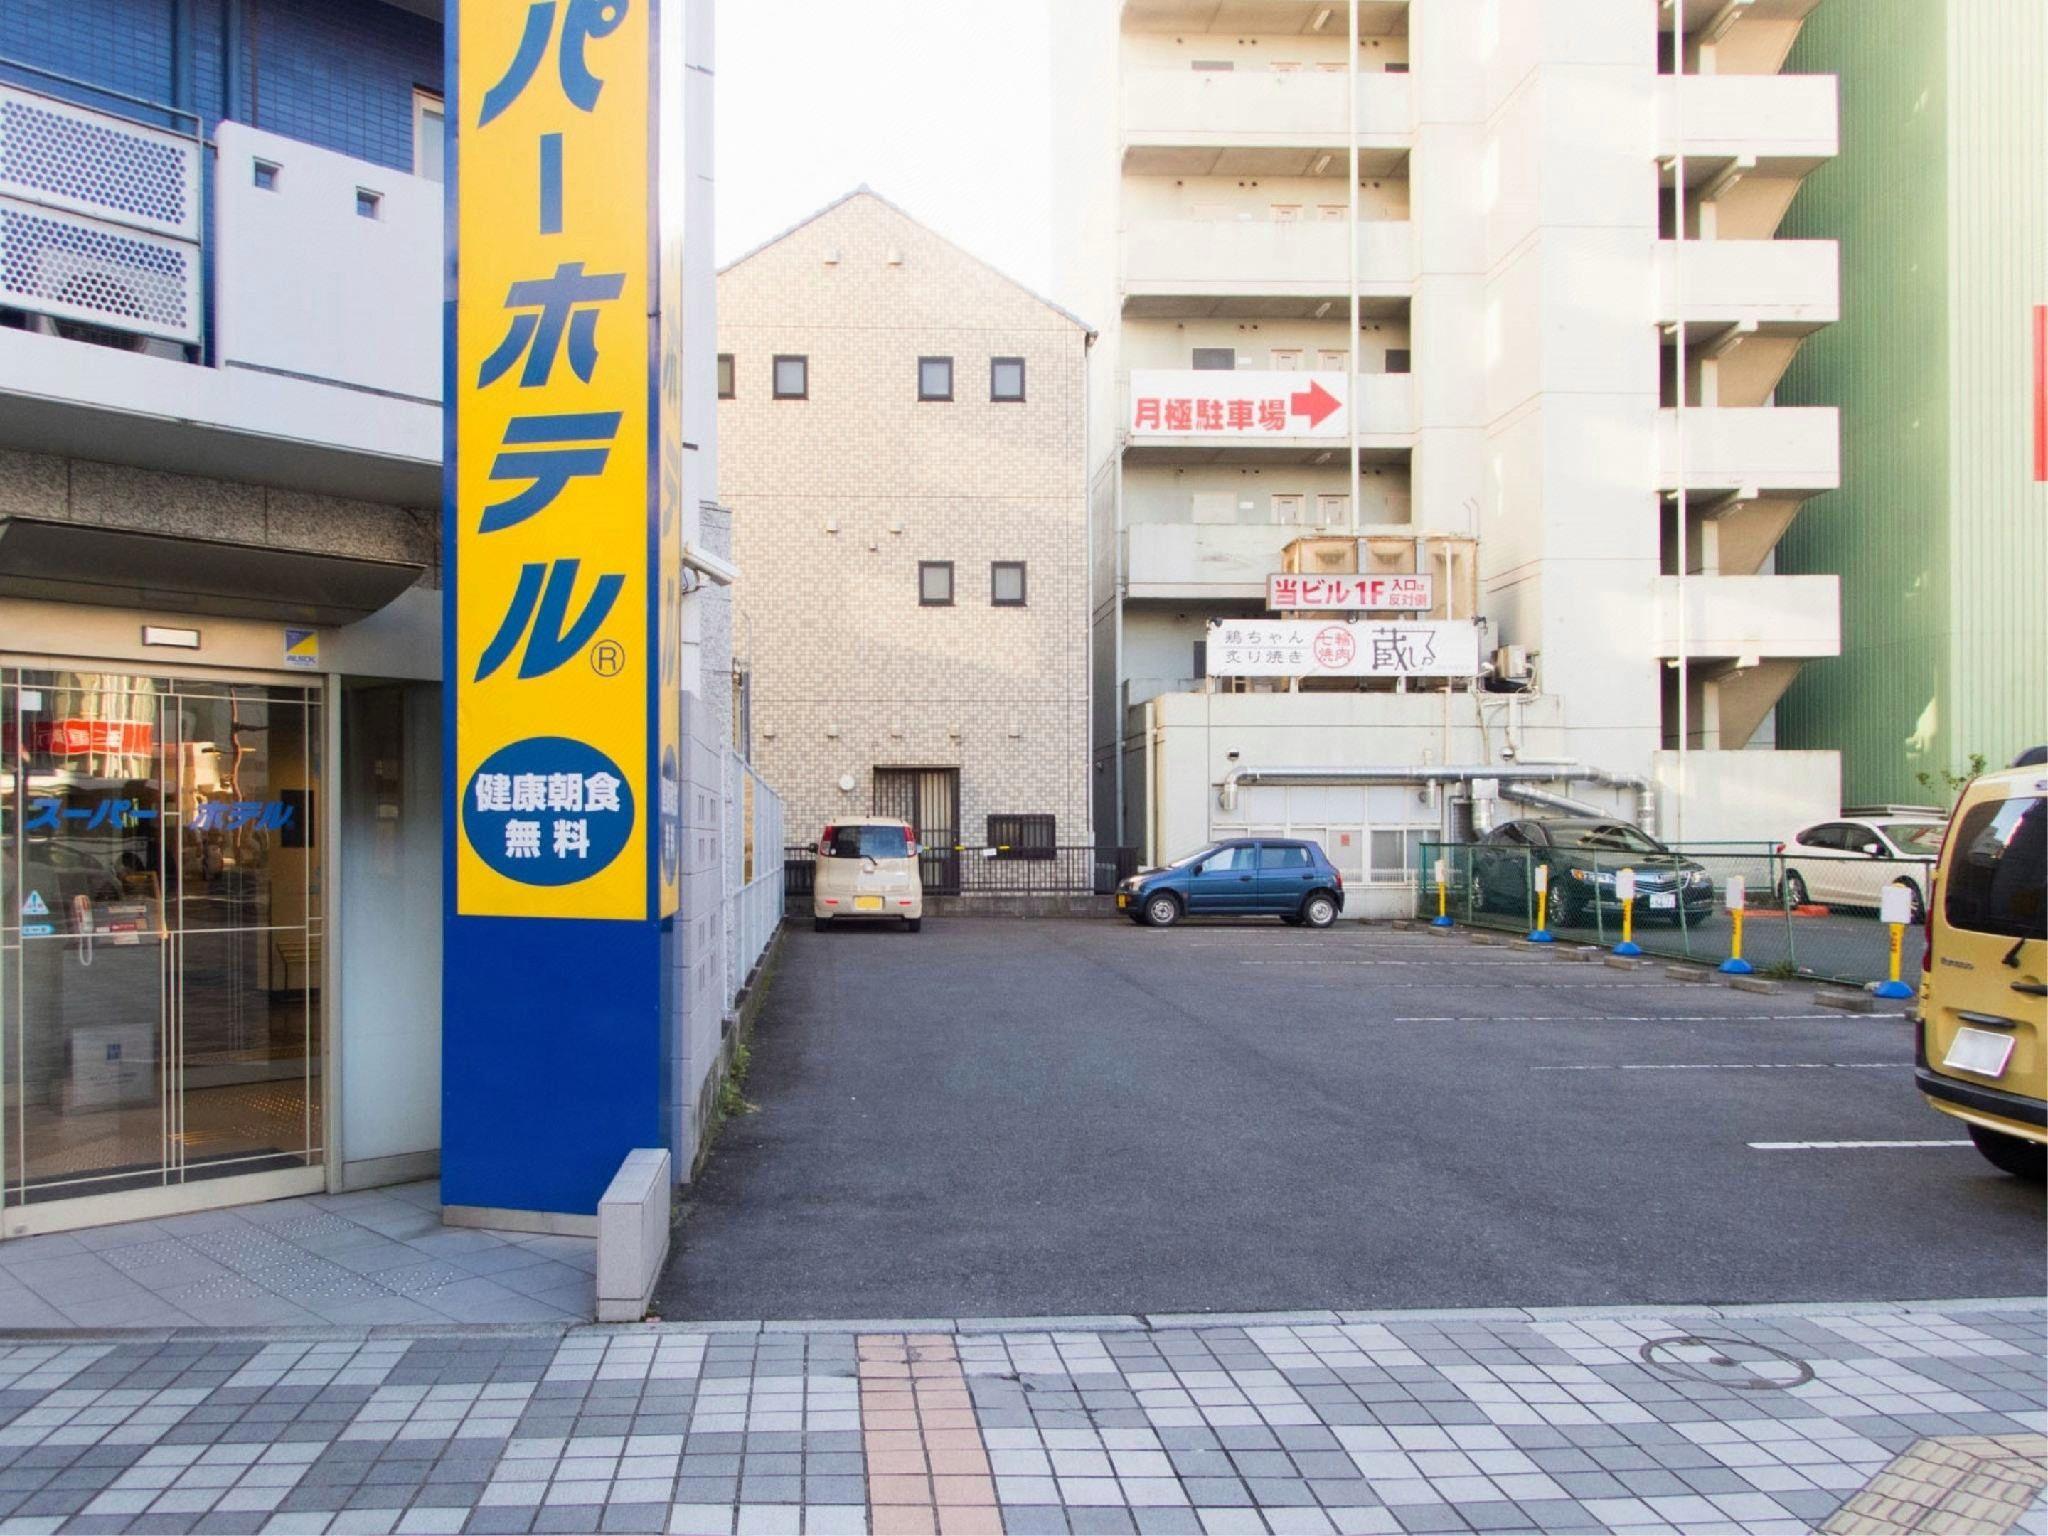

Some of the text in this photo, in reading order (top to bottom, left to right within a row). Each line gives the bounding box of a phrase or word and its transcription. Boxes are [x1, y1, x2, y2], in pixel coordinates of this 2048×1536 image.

[1134, 397, 1287, 431] 月極駐車場
[475, 771, 621, 812] 健康朝食
[25, 798, 294, 831] スーパー ホテル
